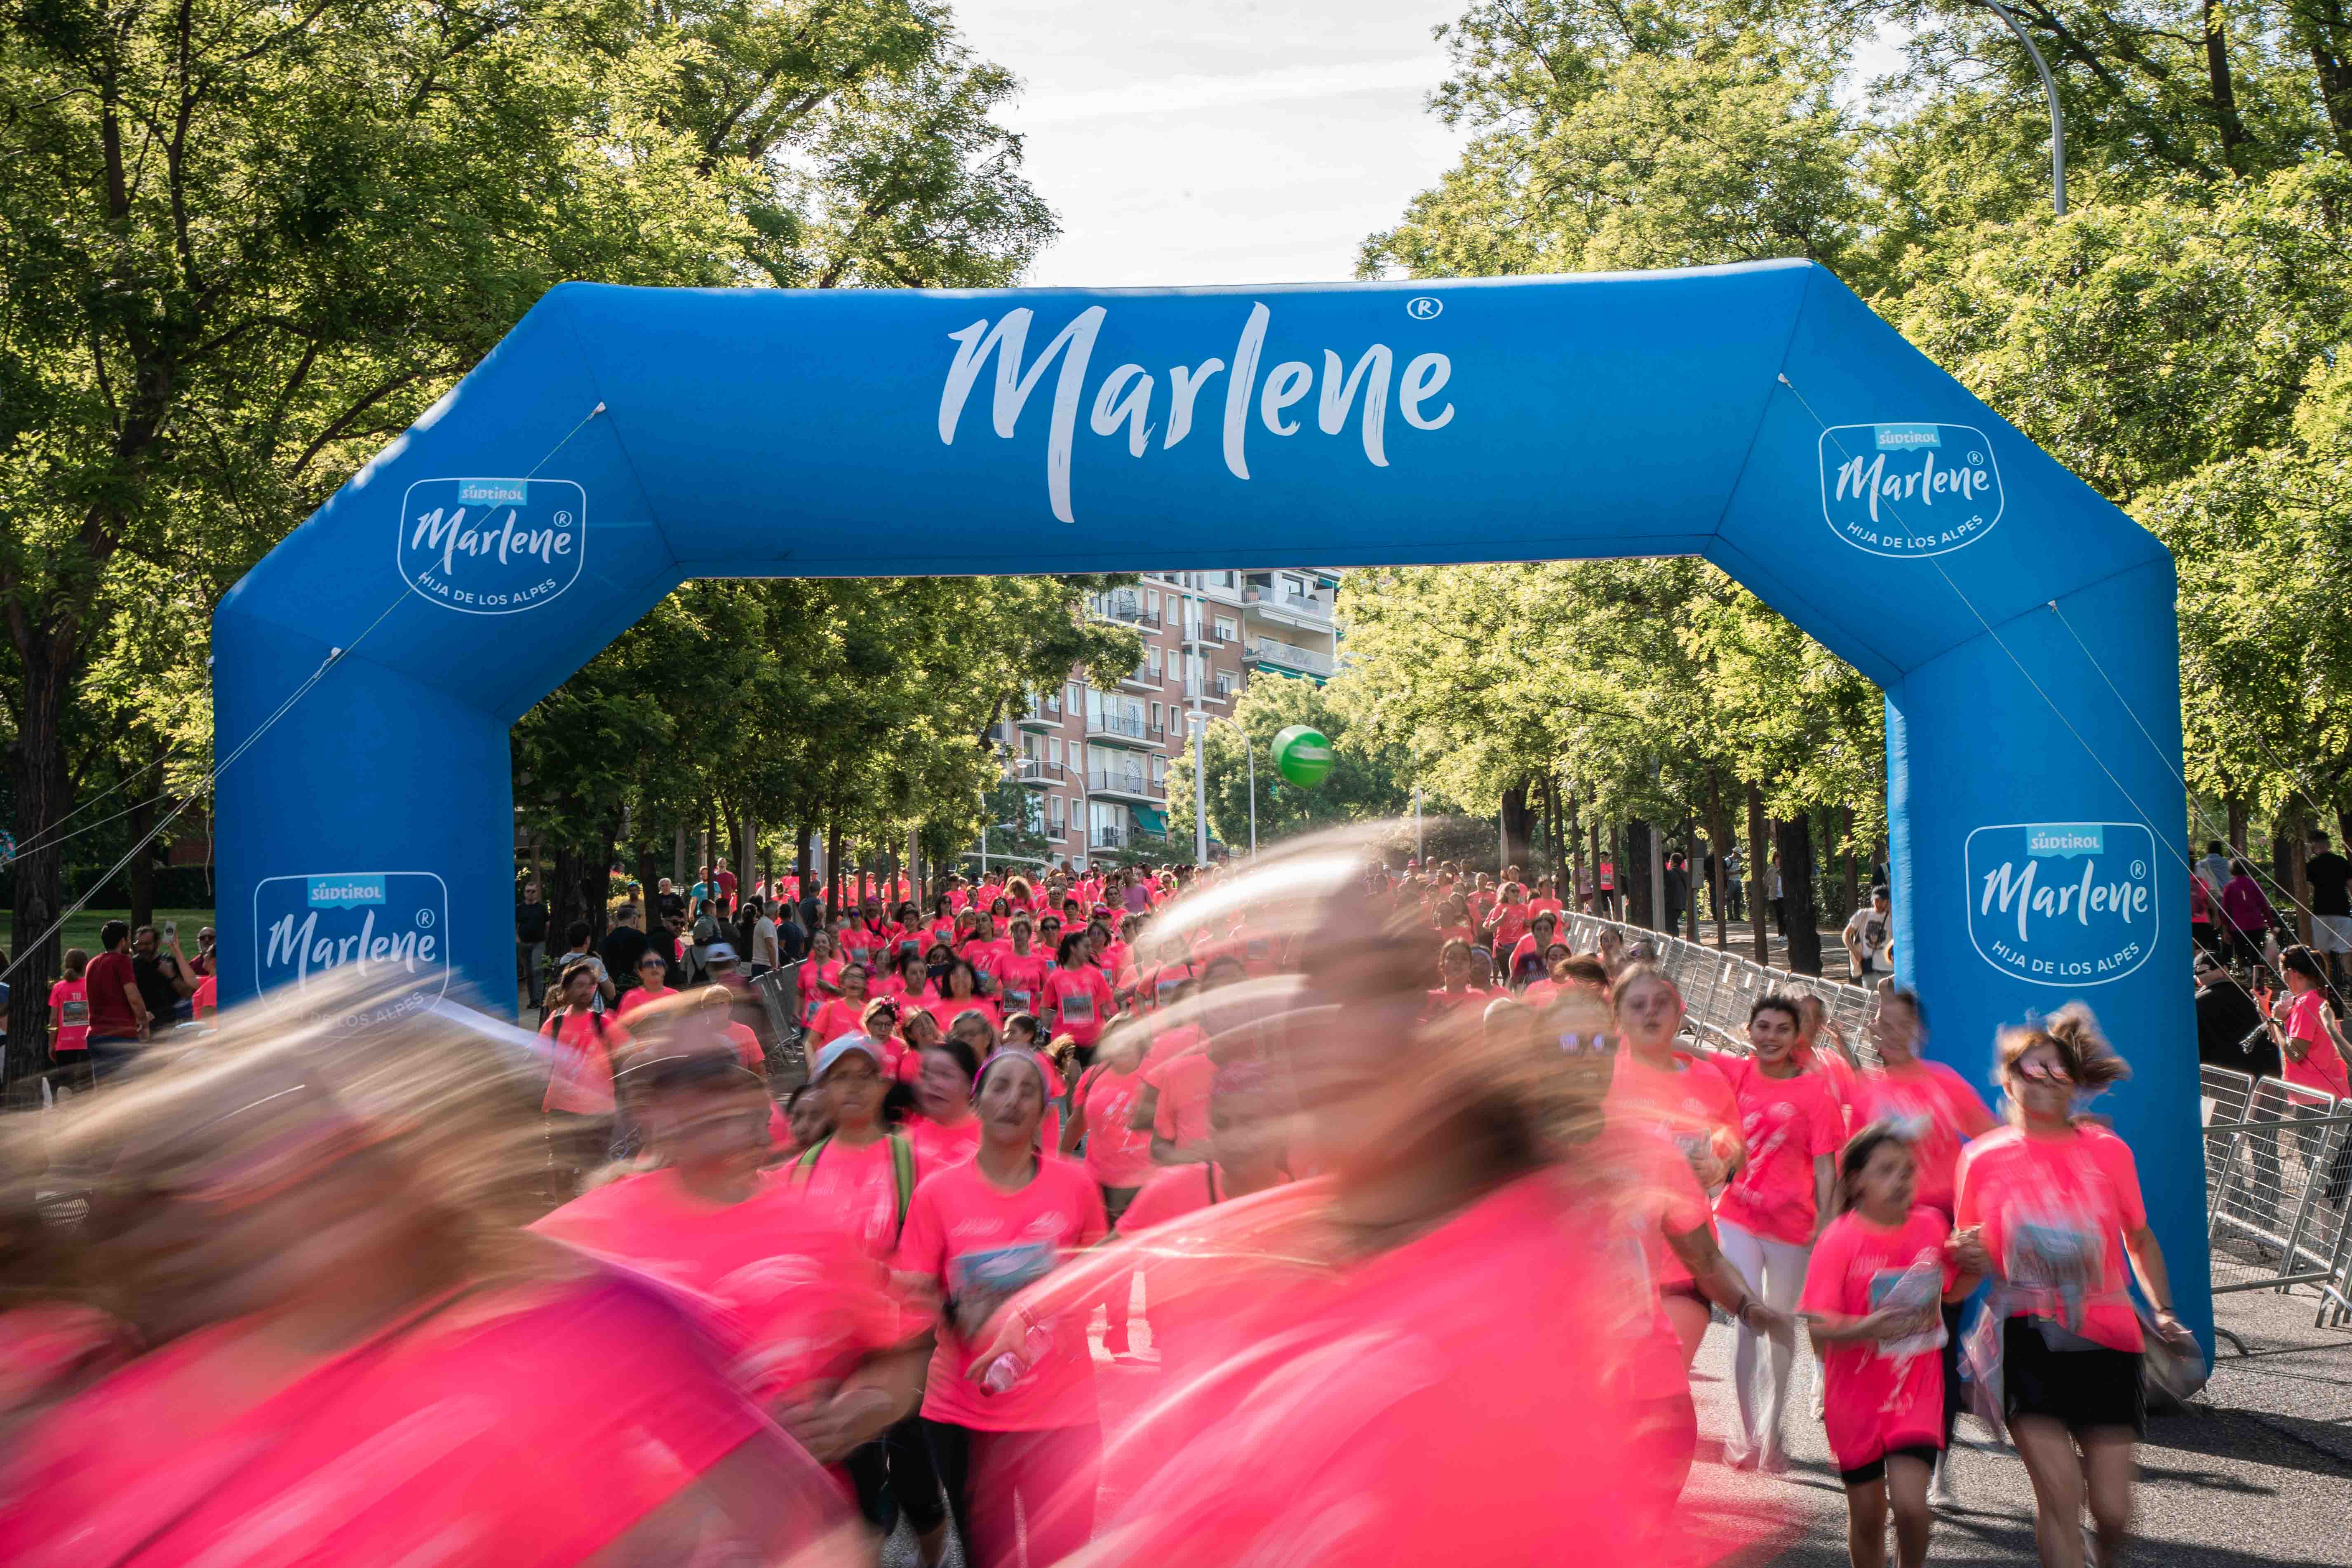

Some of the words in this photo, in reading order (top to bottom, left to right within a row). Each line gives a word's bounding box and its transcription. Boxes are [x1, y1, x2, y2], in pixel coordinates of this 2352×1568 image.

[1847, 522, 1877, 544] HIJA
[1883, 536, 1901, 548] DE
[1908, 536, 1936, 548] LOS
[1941, 515, 1983, 543] ALPES
[418, 572, 449, 596] HIJA
[454, 590, 474, 603] DE
[479, 595, 507, 605] LOS
[513, 578, 556, 603] ALPES
[1993, 940, 2025, 967] HIJA
[2032, 959, 2054, 974] DE
[2060, 962, 2091, 975] LOS
[2097, 942, 2139, 972] ALPES
